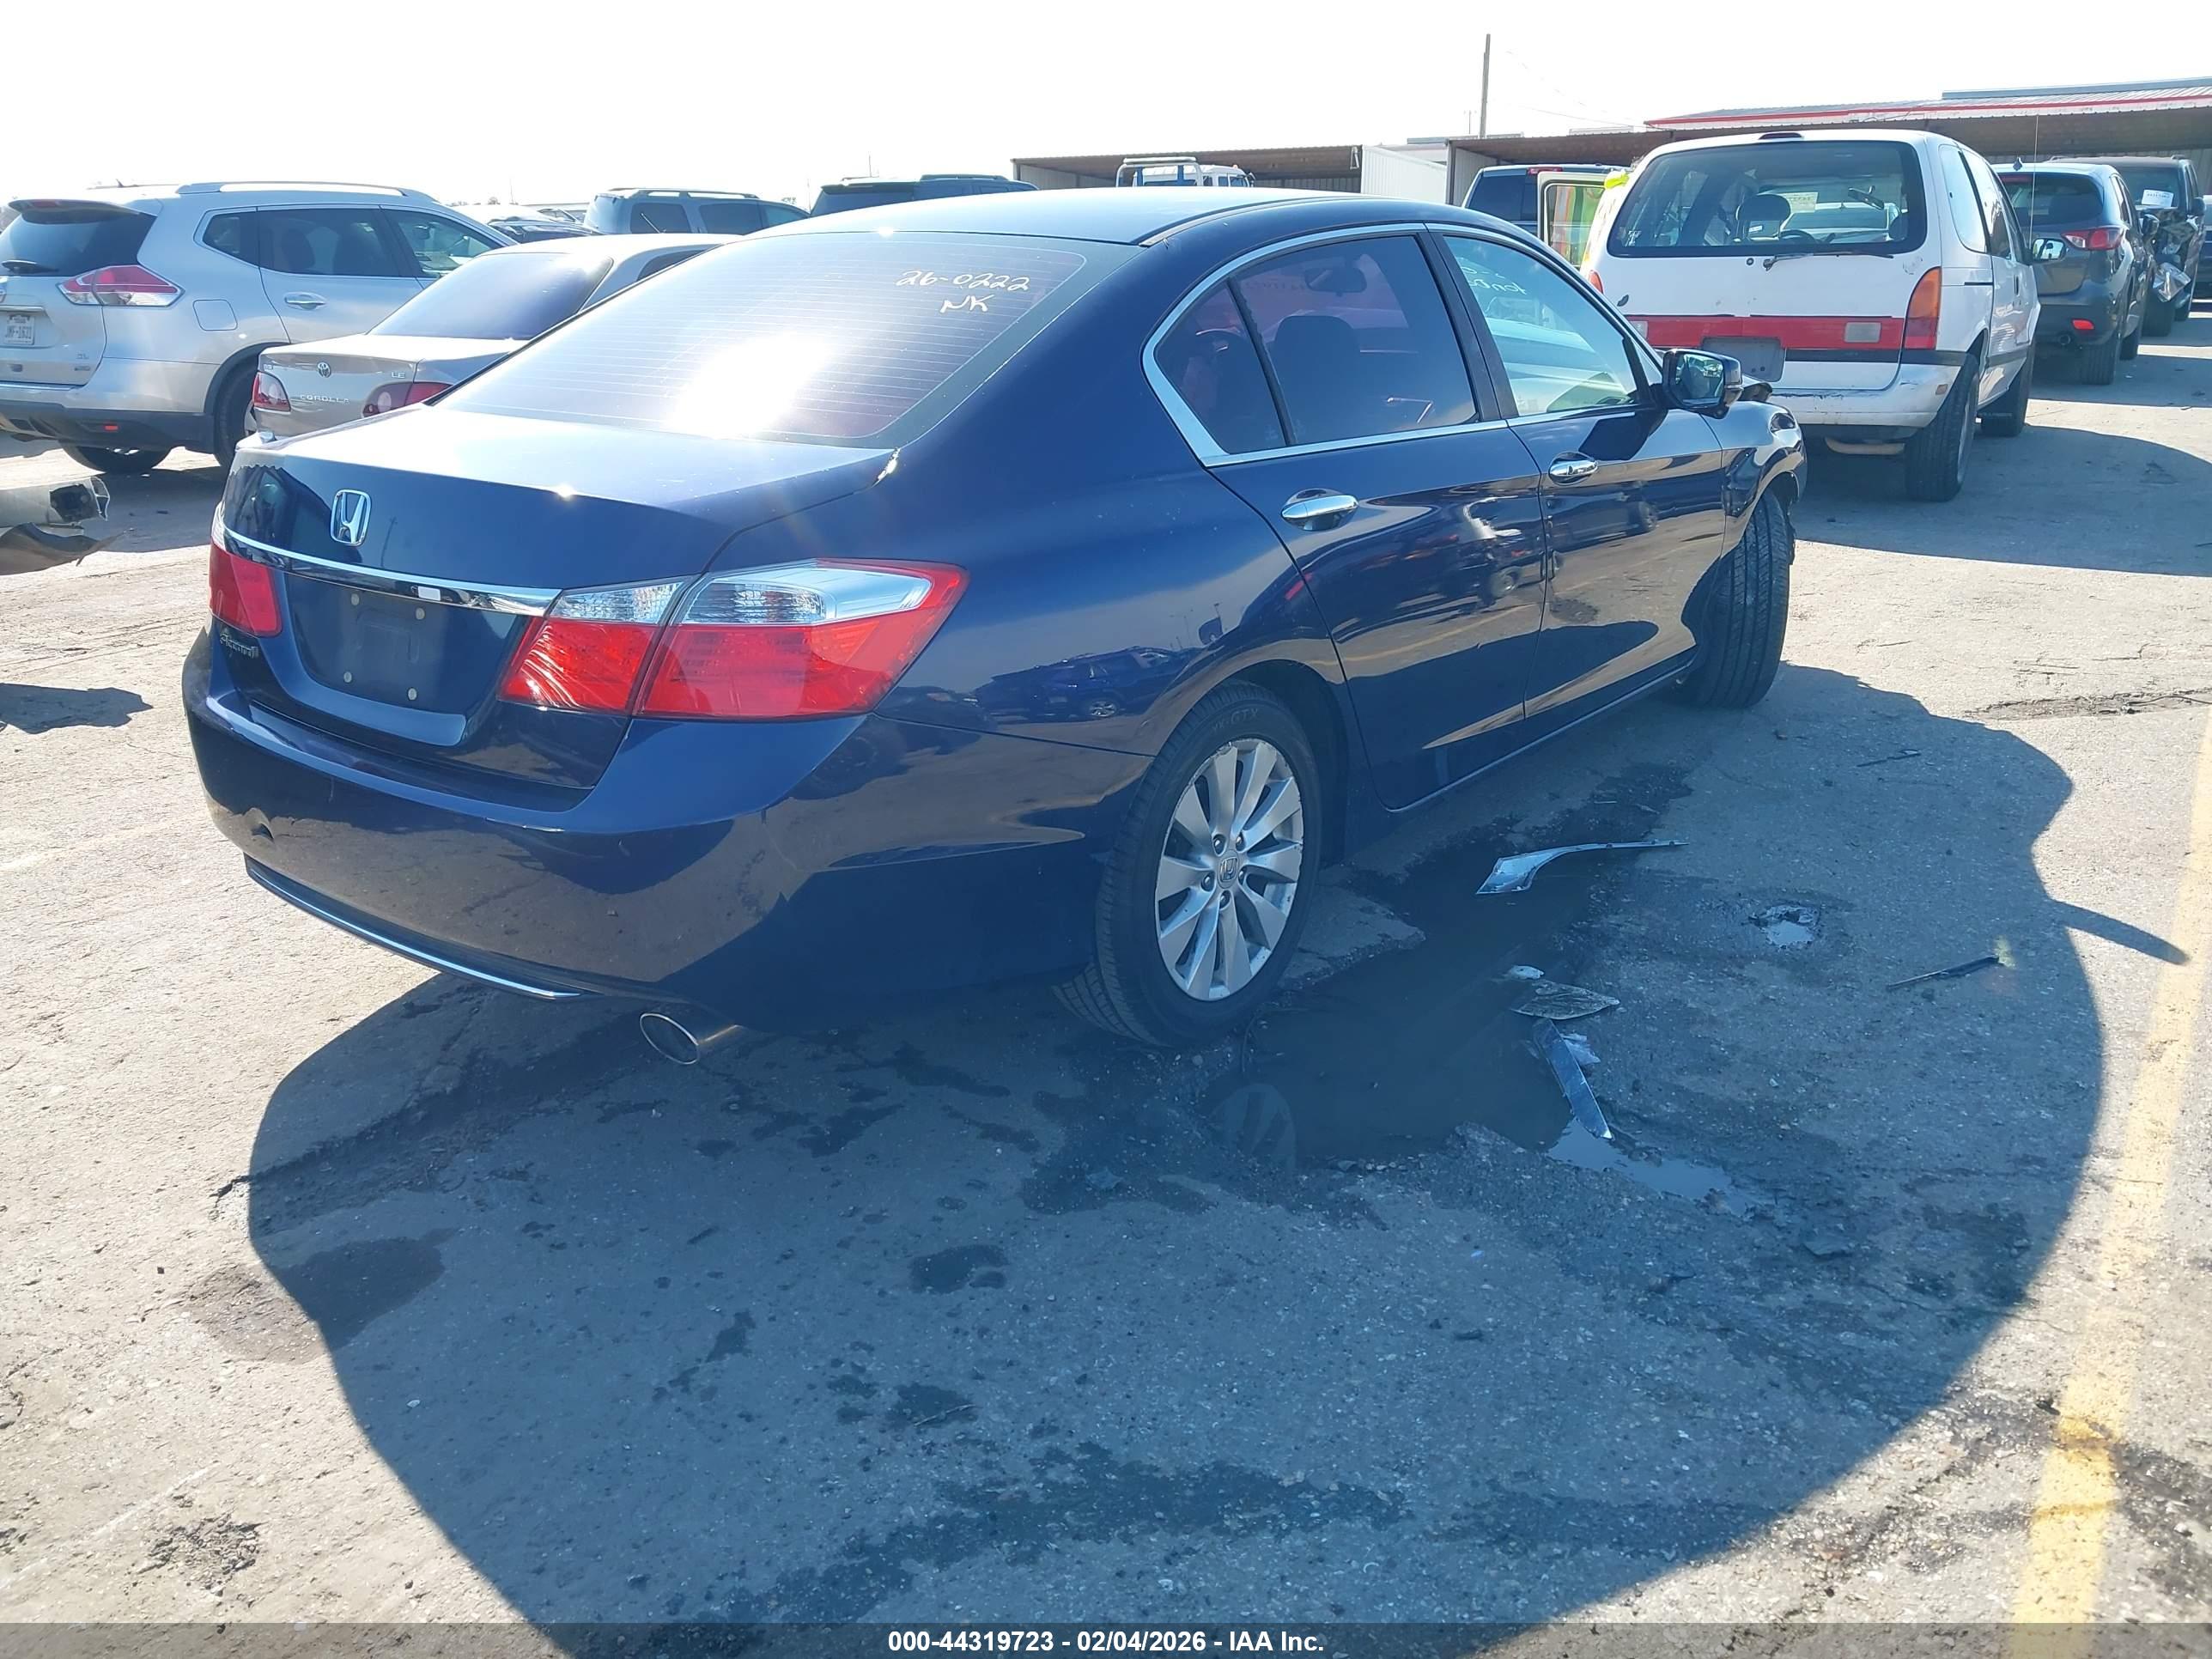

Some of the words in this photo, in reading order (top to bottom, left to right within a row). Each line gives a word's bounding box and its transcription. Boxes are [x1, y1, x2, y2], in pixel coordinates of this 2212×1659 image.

[896, 270, 1030, 291] 26-0222
[939, 294, 995, 313] NK
[300, 393, 350, 404] COROLLA
